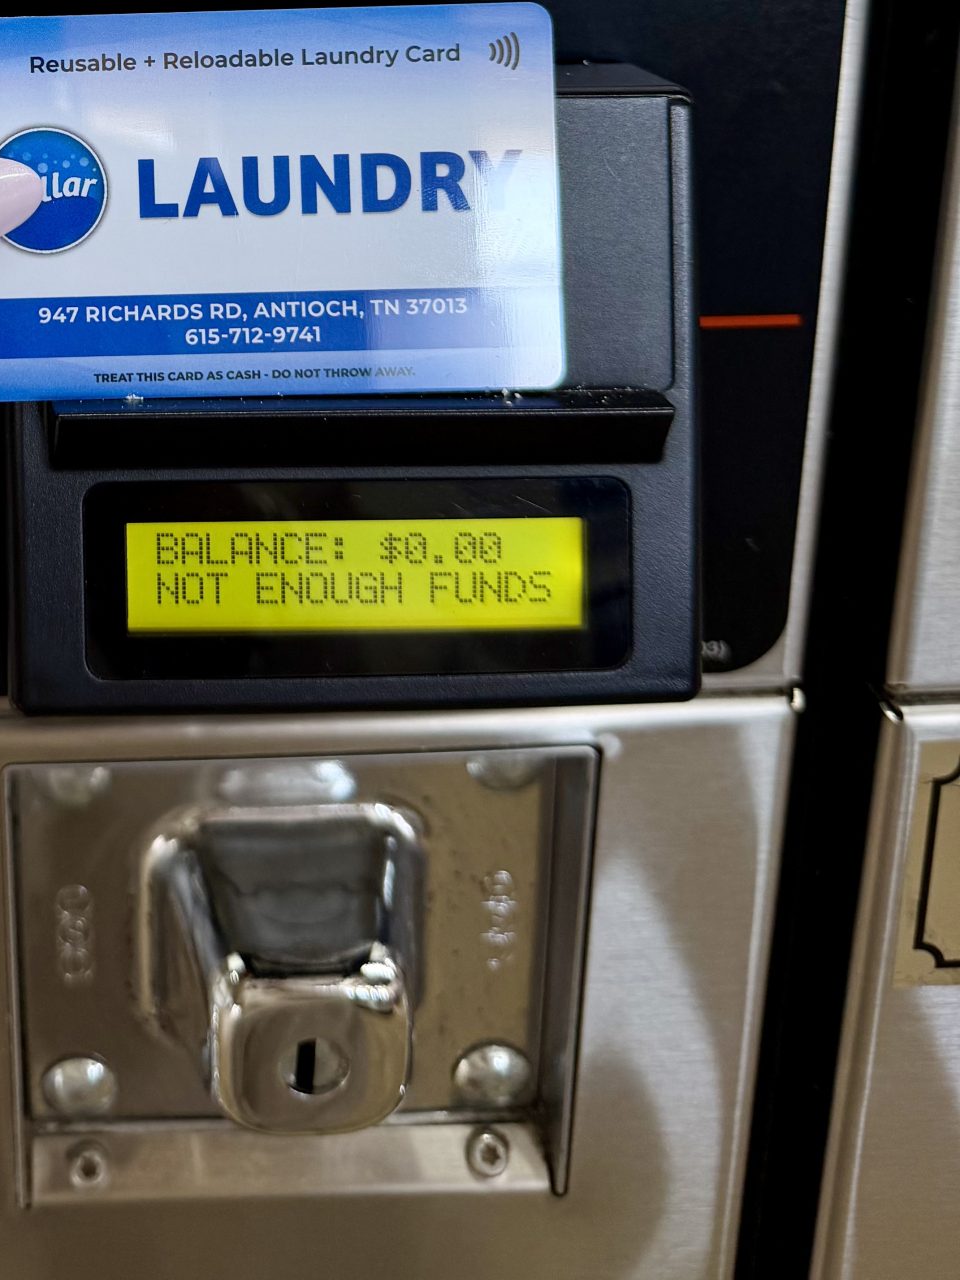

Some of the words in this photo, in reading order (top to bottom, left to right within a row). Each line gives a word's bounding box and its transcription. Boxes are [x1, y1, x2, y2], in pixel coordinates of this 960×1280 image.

[30, 53, 137, 73] Reusable
[144, 55, 156, 67] +
[163, 47, 294, 70] Reloadable
[301, 46, 399, 67] Laundry
[405, 43, 460, 63] Card
[137, 149, 523, 219] LAUNDRY
[38, 306, 79, 324] 947
[85, 303, 203, 322] RICHARDS
[210, 302, 248, 322] RD,
[253, 300, 365, 319] ANTIOCH,
[370, 299, 400, 316] TN
[406, 297, 468, 315] 37013
[185, 326, 321, 345] 615-712-9741
[94, 372, 133, 383] TREAT
[136, 371, 165, 382] THIS
[167, 370, 203, 381] CARD
[206, 370, 224, 380] AS
[226, 369, 261, 380] CASH
[272, 368, 291, 379] DO
[294, 368, 321, 378] NOT
[324, 367, 371, 378] THROW
[156, 532, 344, 565] BALANCE:
[380, 532, 502, 564] $0.00
[157, 572, 228, 605] NOT
[256, 571, 403, 605] ENOUGH
[430, 570, 551, 603] FUNDS
